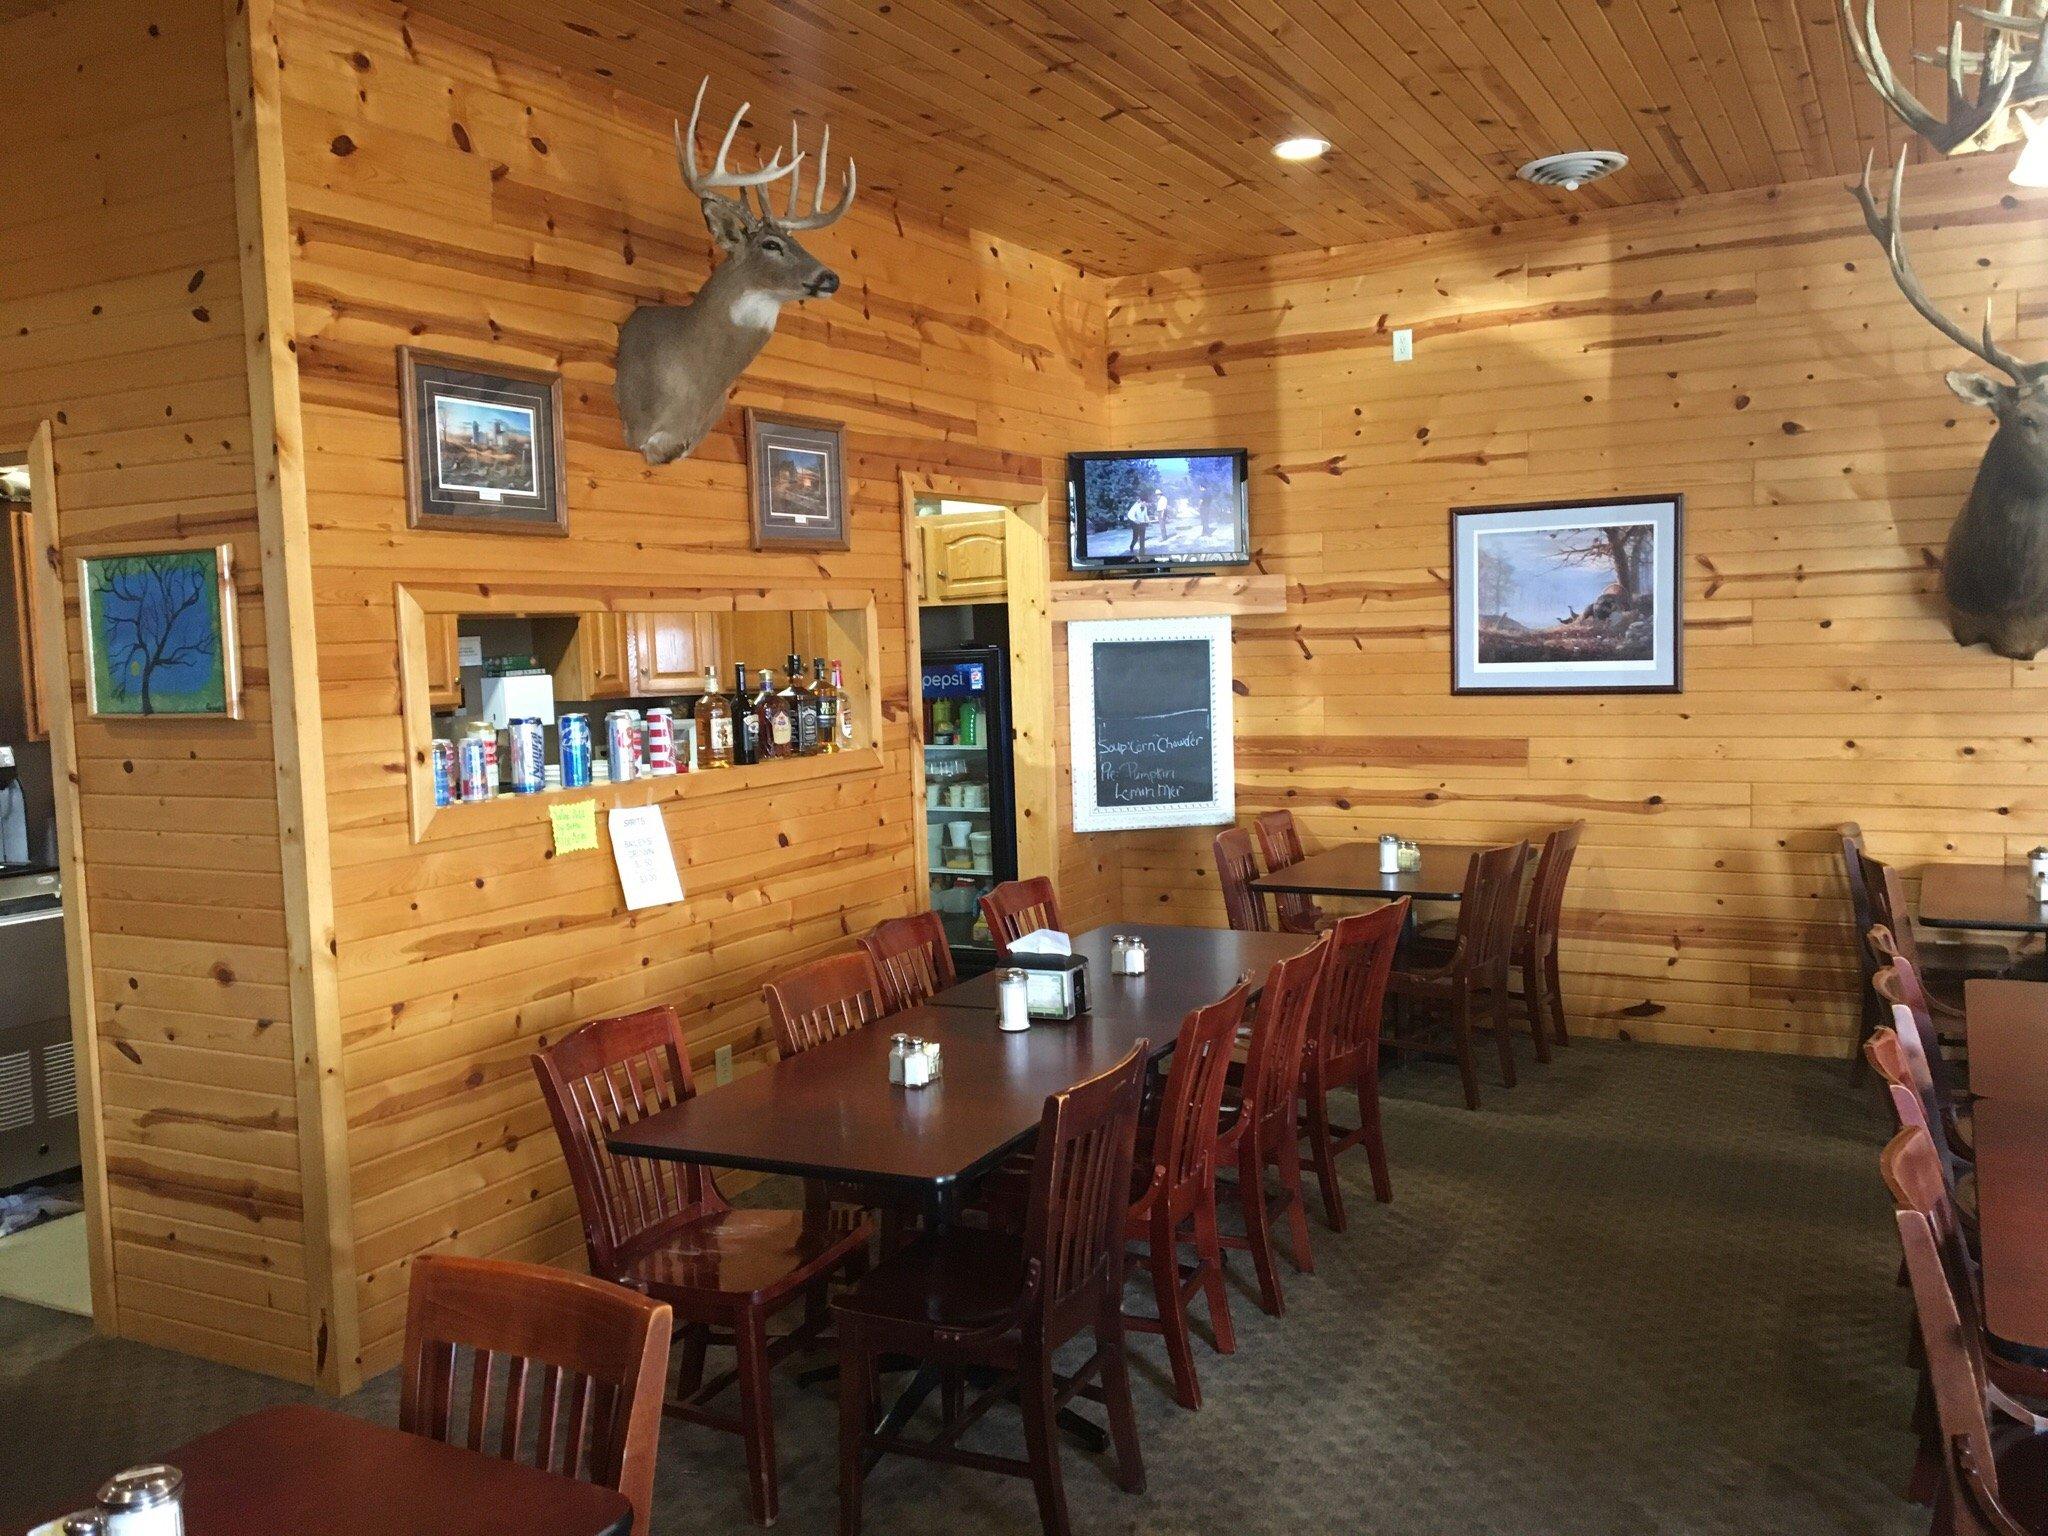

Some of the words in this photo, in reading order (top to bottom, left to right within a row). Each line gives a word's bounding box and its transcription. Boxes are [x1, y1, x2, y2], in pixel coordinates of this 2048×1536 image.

[922, 672, 963, 689] pepsi
[1157, 732, 1204, 753] Chowder
[1119, 761, 1175, 784] Pumpkin
[1115, 783, 1156, 801] Lemon
[1157, 783, 1185, 800] Mer
